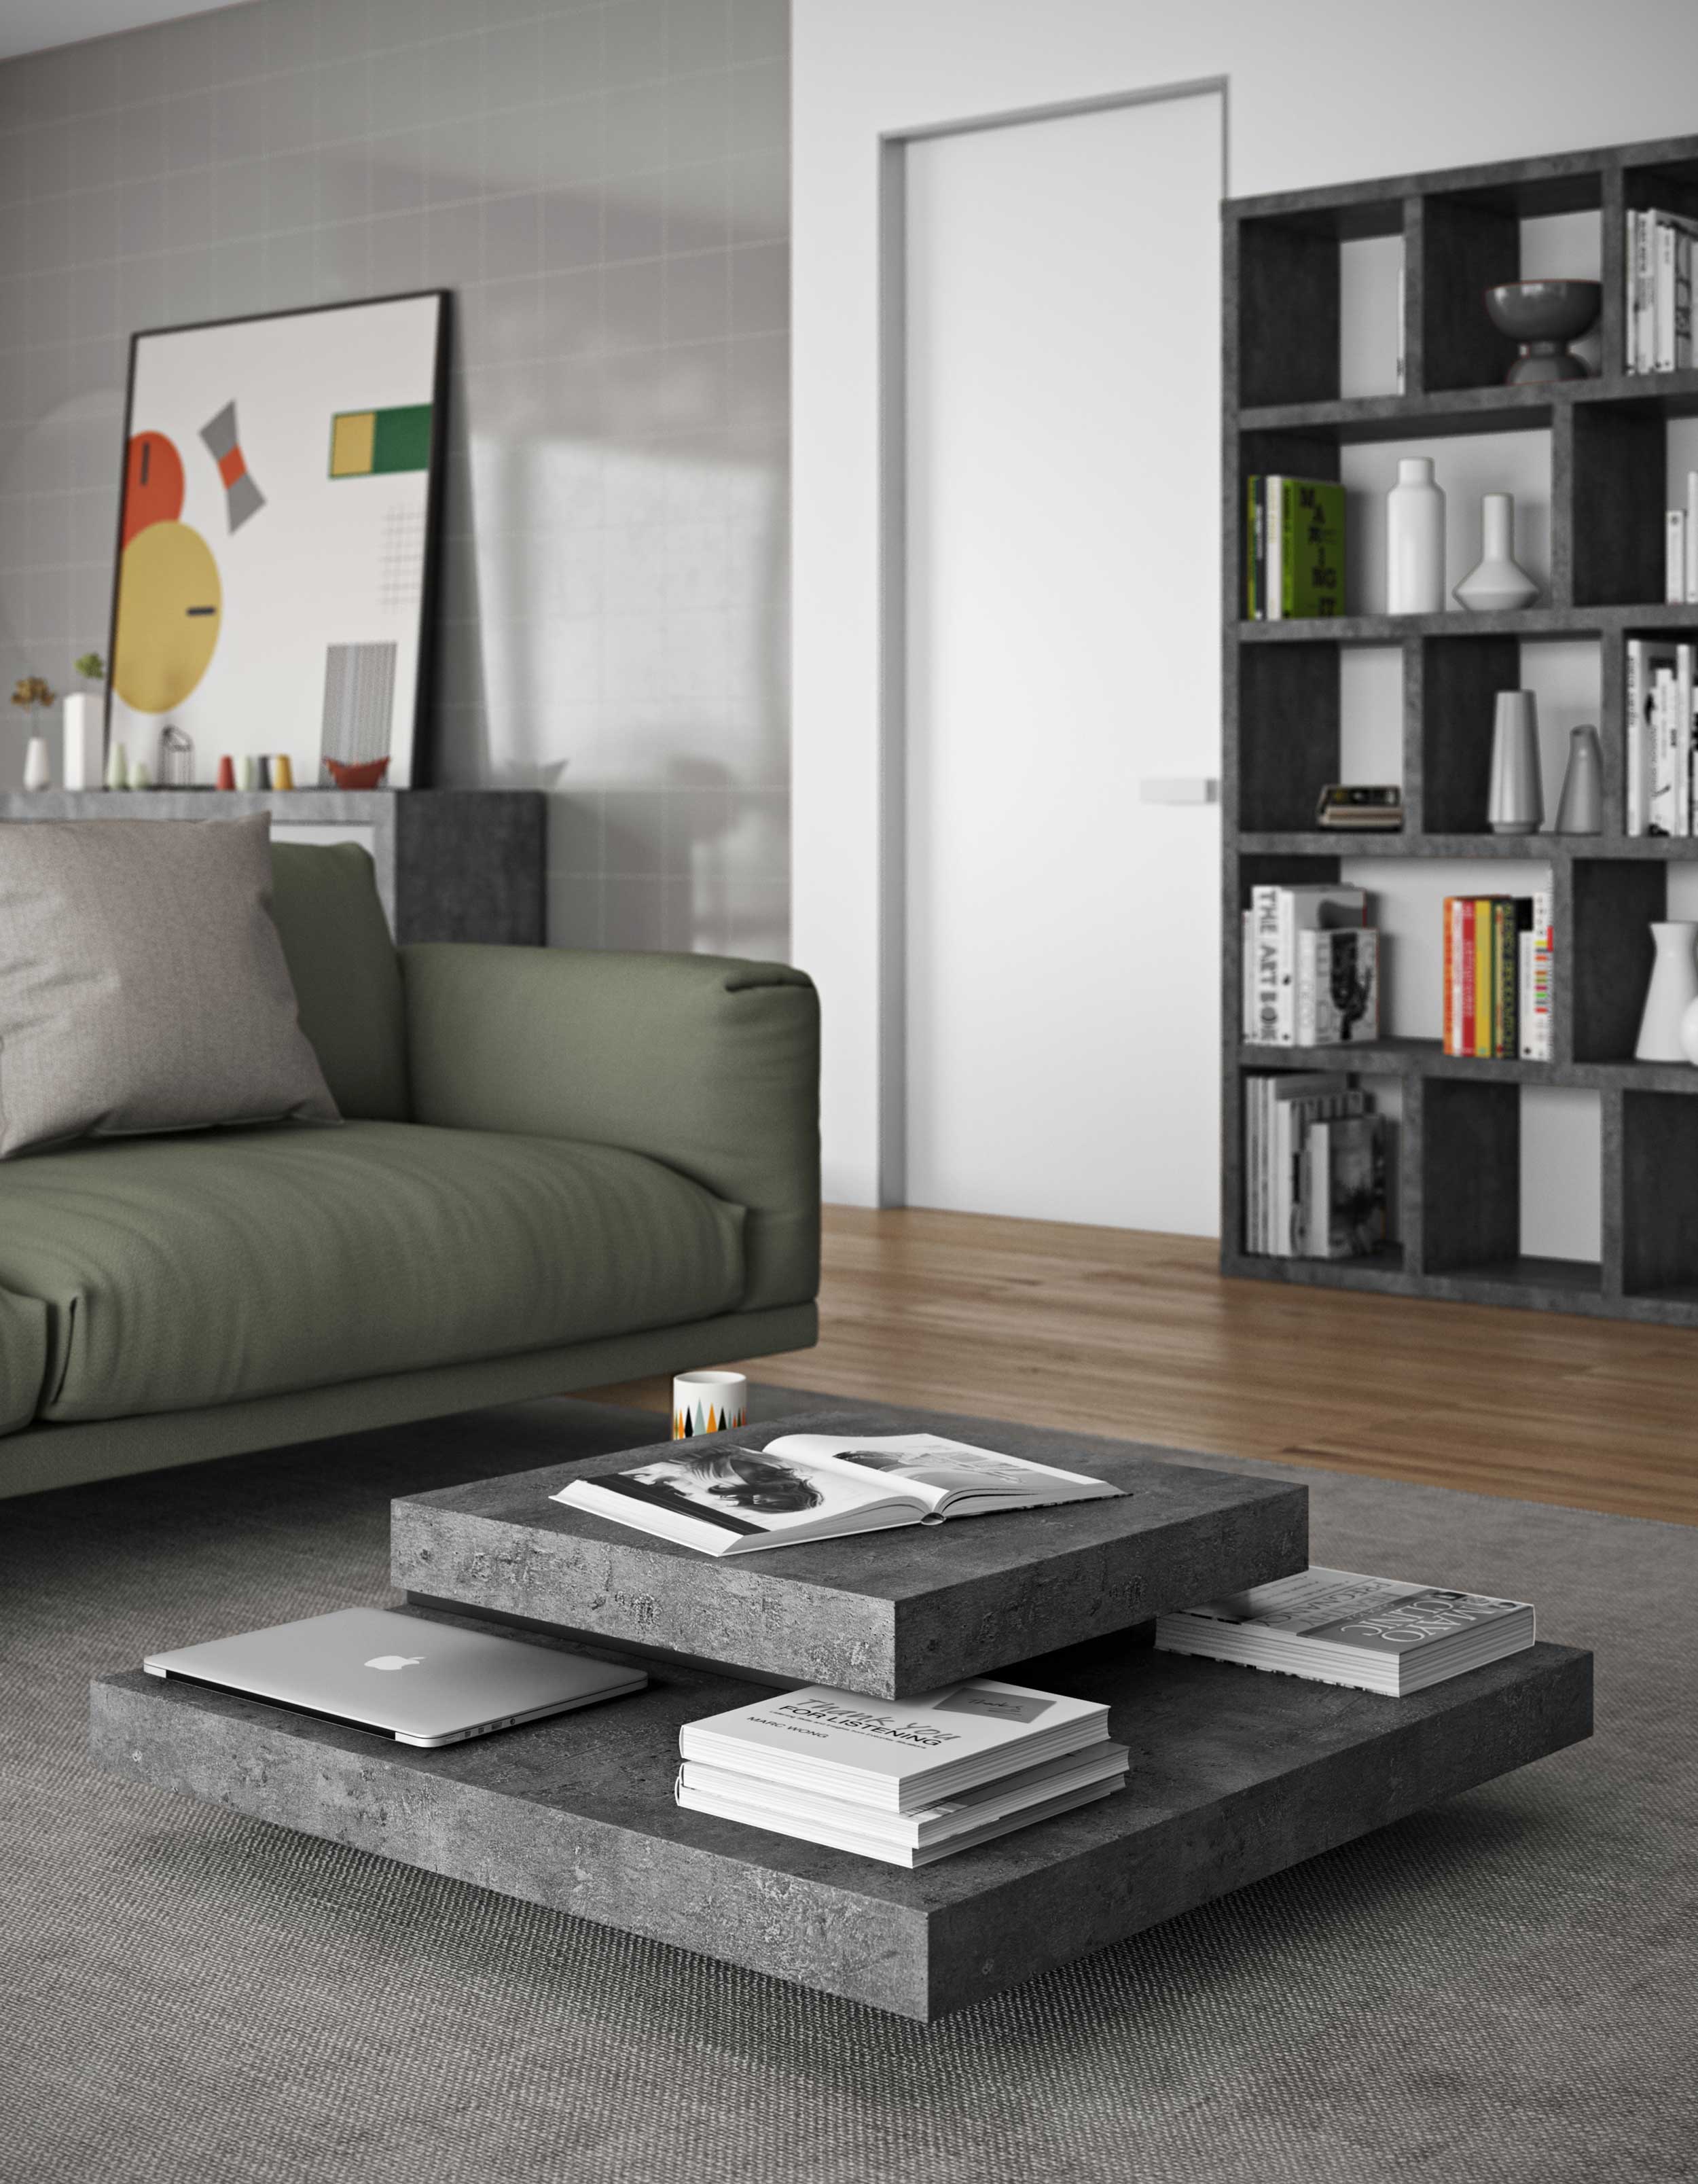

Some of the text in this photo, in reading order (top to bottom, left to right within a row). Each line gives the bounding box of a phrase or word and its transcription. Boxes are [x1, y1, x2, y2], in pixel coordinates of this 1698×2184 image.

[1260, 891, 1278, 933] THE
[1260, 945, 1278, 985] ART
[1256, 1581, 1392, 1627] PREGNANCY
[1299, 1592, 1401, 1626] HEALTHY
[1341, 1600, 1454, 1636] CLINIC
[1381, 1605, 1496, 1642] MAYO
[747, 1717, 829, 1738] MARC WONG
[778, 1705, 942, 1746] FOR LISTENING
[797, 1699, 962, 1740] Thank You
